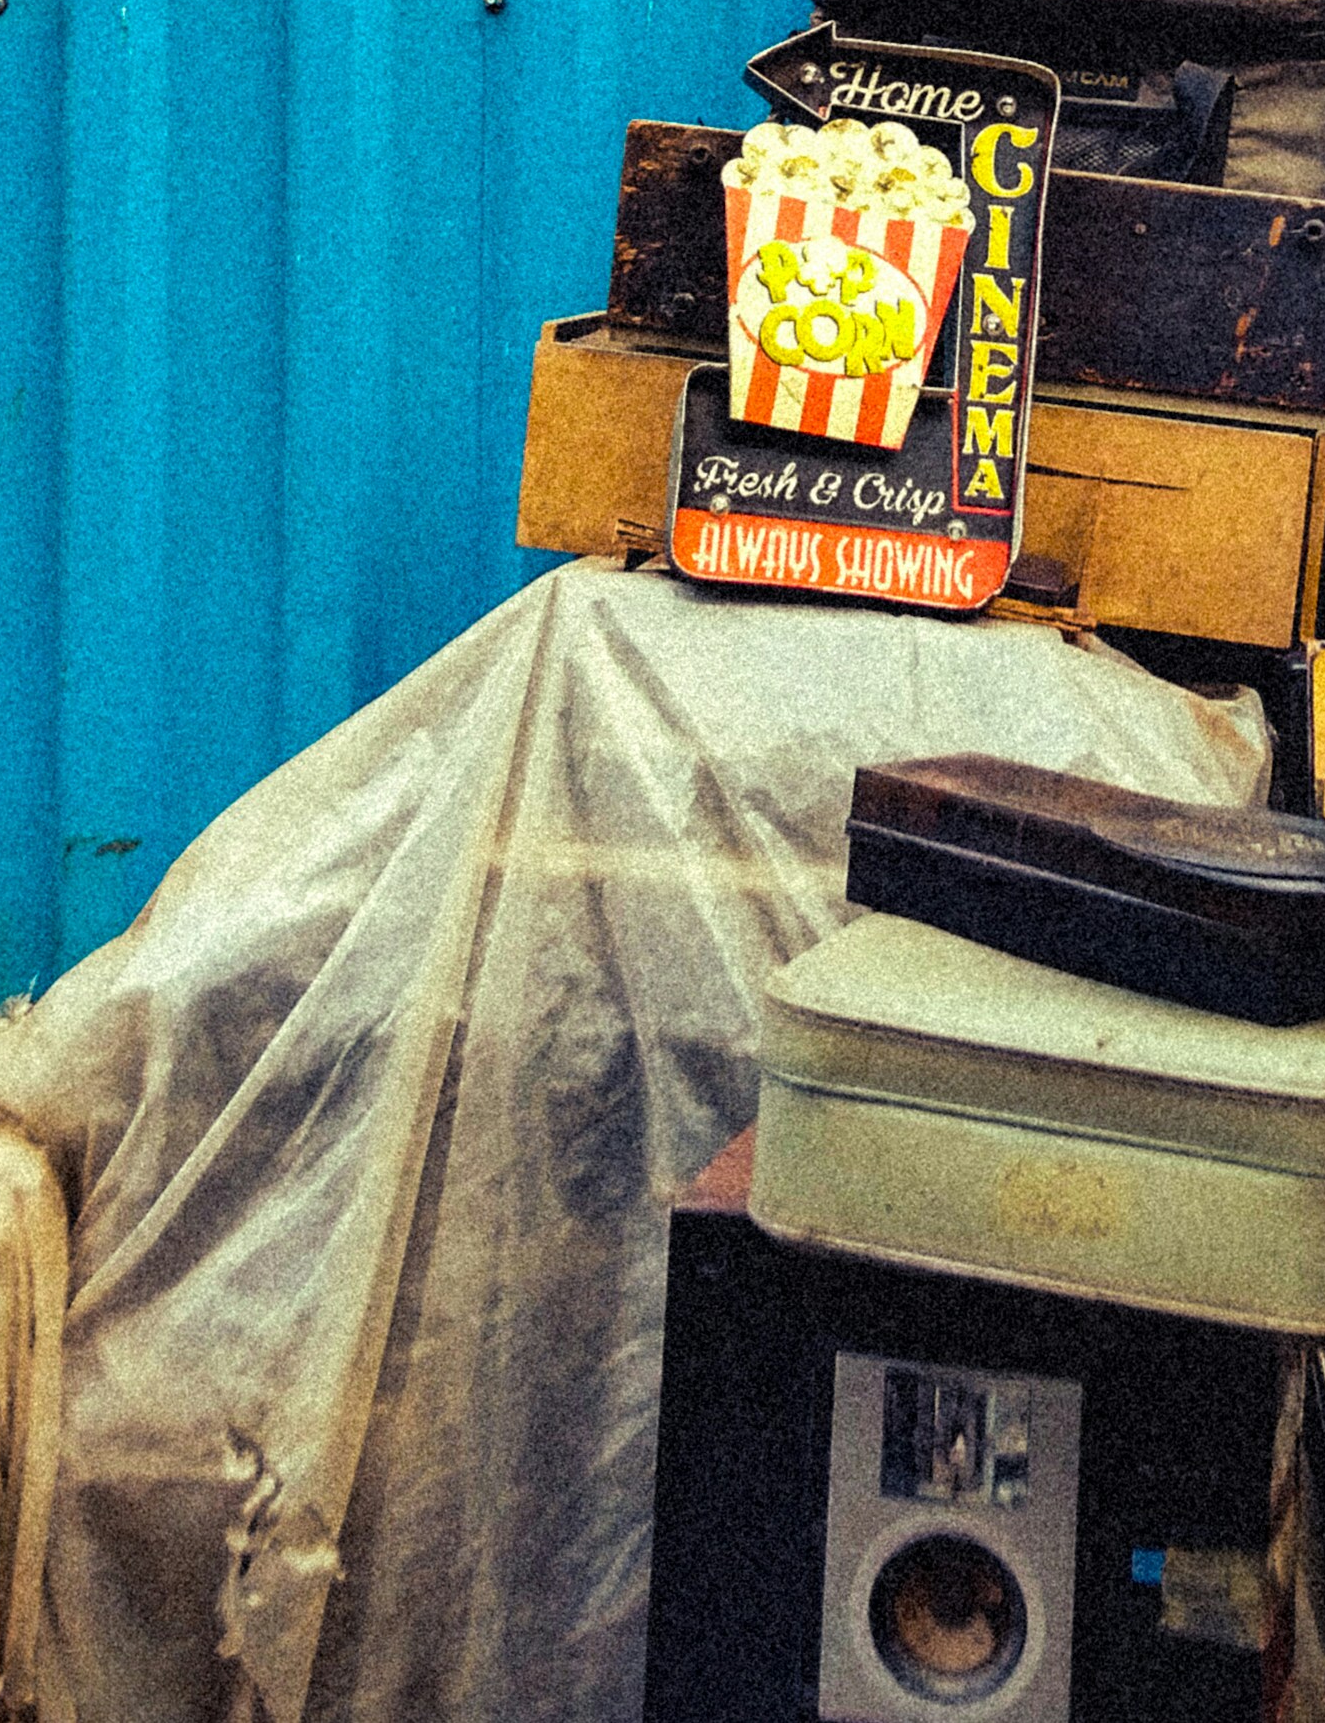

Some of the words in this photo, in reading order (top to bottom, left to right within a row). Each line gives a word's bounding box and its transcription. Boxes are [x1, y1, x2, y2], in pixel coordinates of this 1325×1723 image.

[828, 62, 984, 122] Home
[759, 298, 916, 377] CORN
[964, 123, 1039, 500] CINEMA
[695, 455, 799, 502] Fresh
[809, 472, 842, 505] &
[853, 473, 947, 527] Crisp
[692, 520, 825, 584] ALWAYS
[835, 536, 974, 602] SHOWING
